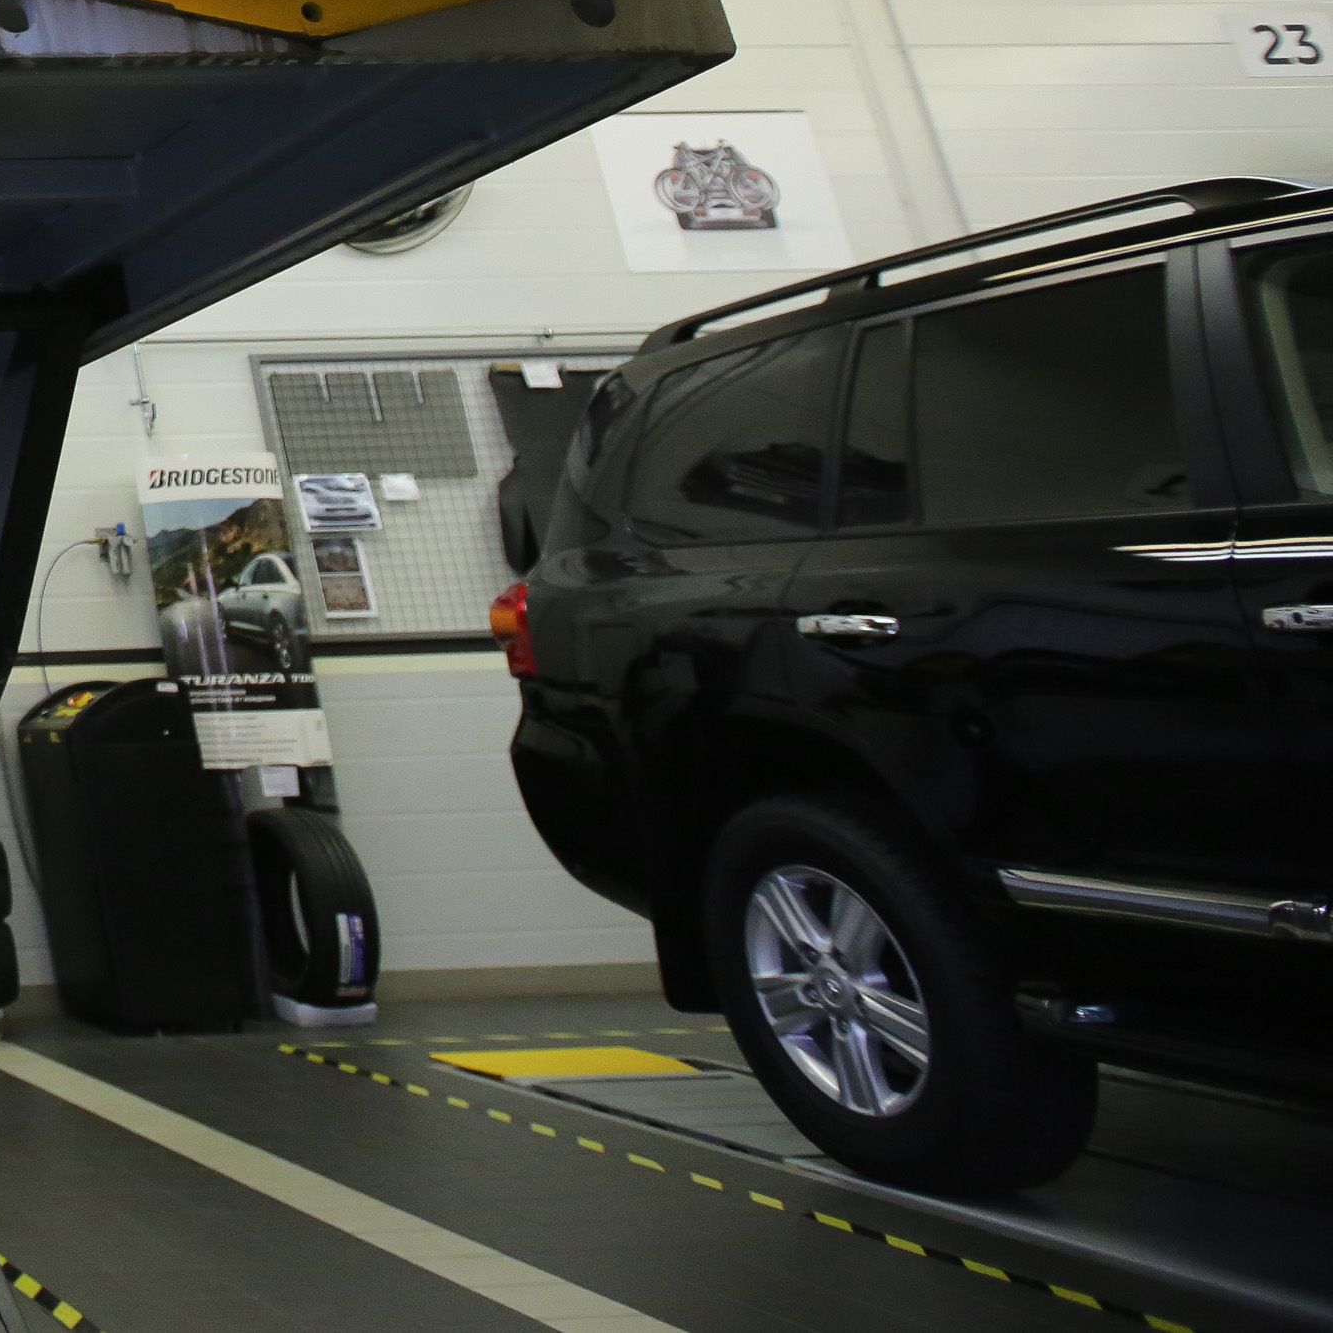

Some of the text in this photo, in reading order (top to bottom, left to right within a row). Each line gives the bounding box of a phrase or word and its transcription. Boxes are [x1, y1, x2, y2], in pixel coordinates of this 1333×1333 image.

[1250, 23, 1320, 65] 23
[148, 467, 281, 490] BRIDGESTONE
[181, 671, 286, 686] TURANZA
